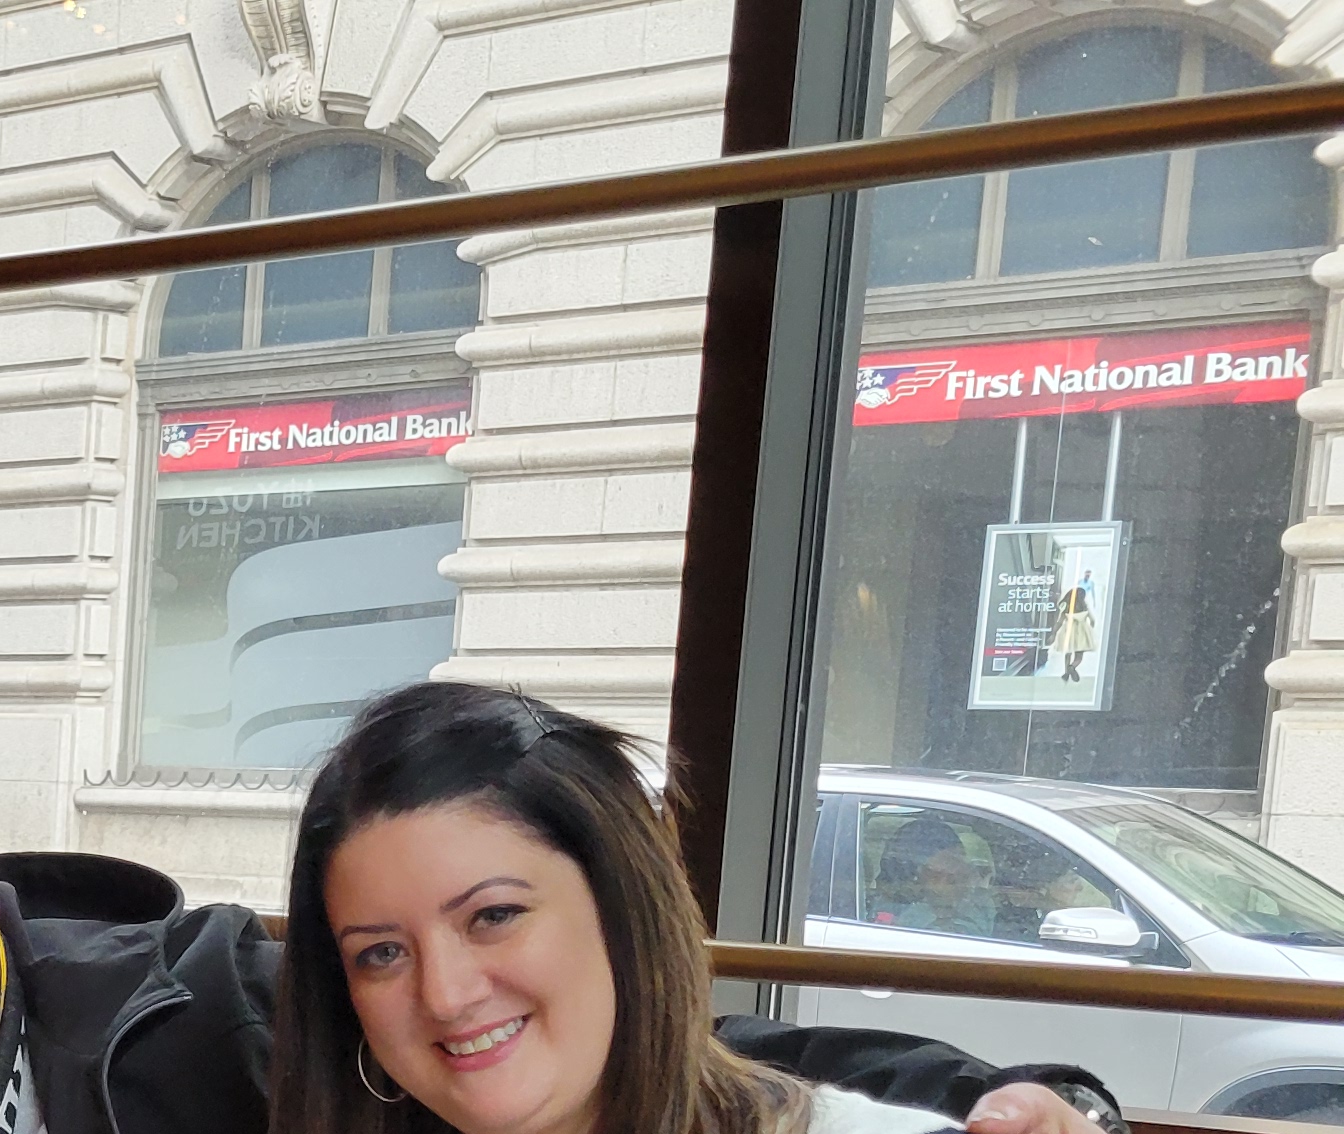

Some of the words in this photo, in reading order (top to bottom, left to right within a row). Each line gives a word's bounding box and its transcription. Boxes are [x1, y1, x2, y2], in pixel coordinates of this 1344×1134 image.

[945, 369, 1024, 400] First
[1030, 355, 1194, 396] National
[1203, 348, 1310, 385] Bank
[226, 426, 283, 453] First
[286, 415, 399, 450] National
[404, 411, 473, 440] Bank
[998, 573, 1055, 586] Success
[1008, 587, 1050, 599] starts
[998, 601, 1013, 612] at
